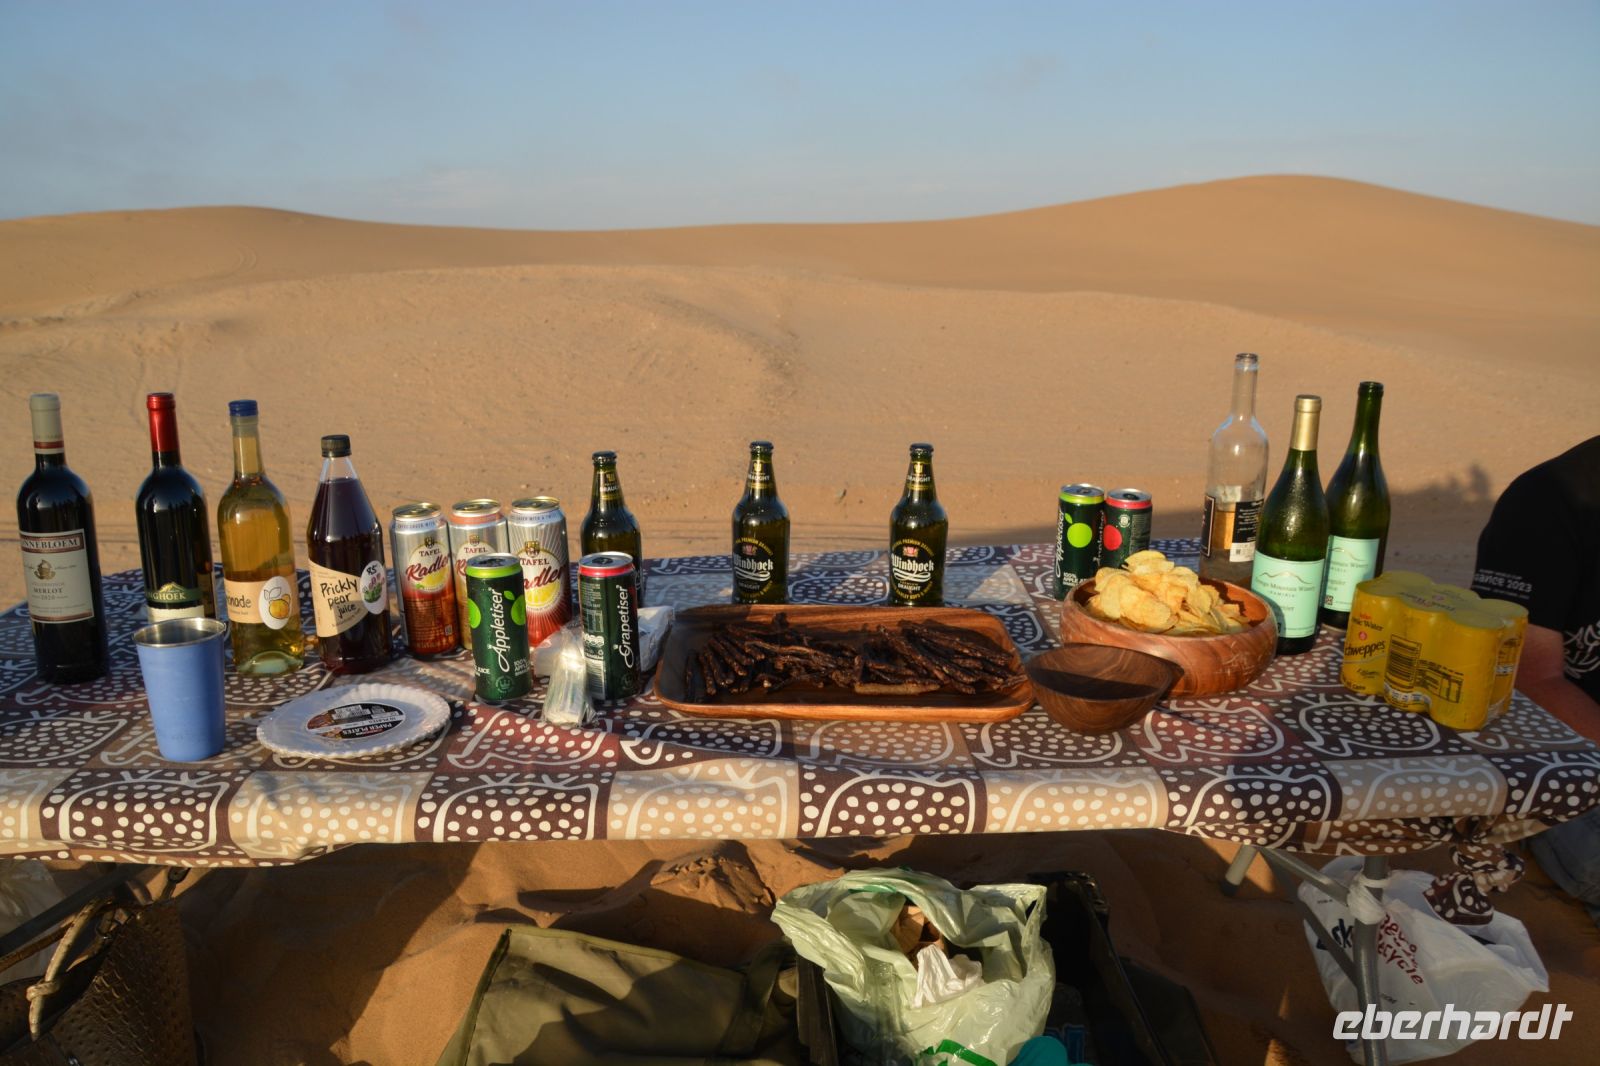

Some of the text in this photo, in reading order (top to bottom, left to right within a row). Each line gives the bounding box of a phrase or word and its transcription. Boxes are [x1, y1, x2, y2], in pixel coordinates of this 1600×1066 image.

[23, 538, 79, 549] NNEBLOEM
[418, 548, 441, 557] TAFEL
[405, 554, 450, 581] Radle
[519, 557, 550, 566] TAFEL
[733, 553, 774, 574] Windhoek
[890, 553, 935, 575] Windhoek
[320, 577, 358, 598] Prickly
[1506, 579, 1533, 593] 2023
[327, 592, 352, 610] pear
[337, 603, 357, 619] juice
[489, 587, 511, 673] Appletiser
[616, 585, 634, 669] Grapetiser
[1344, 640, 1386, 659] chweppes
[342, 727, 369, 735] PLATES
